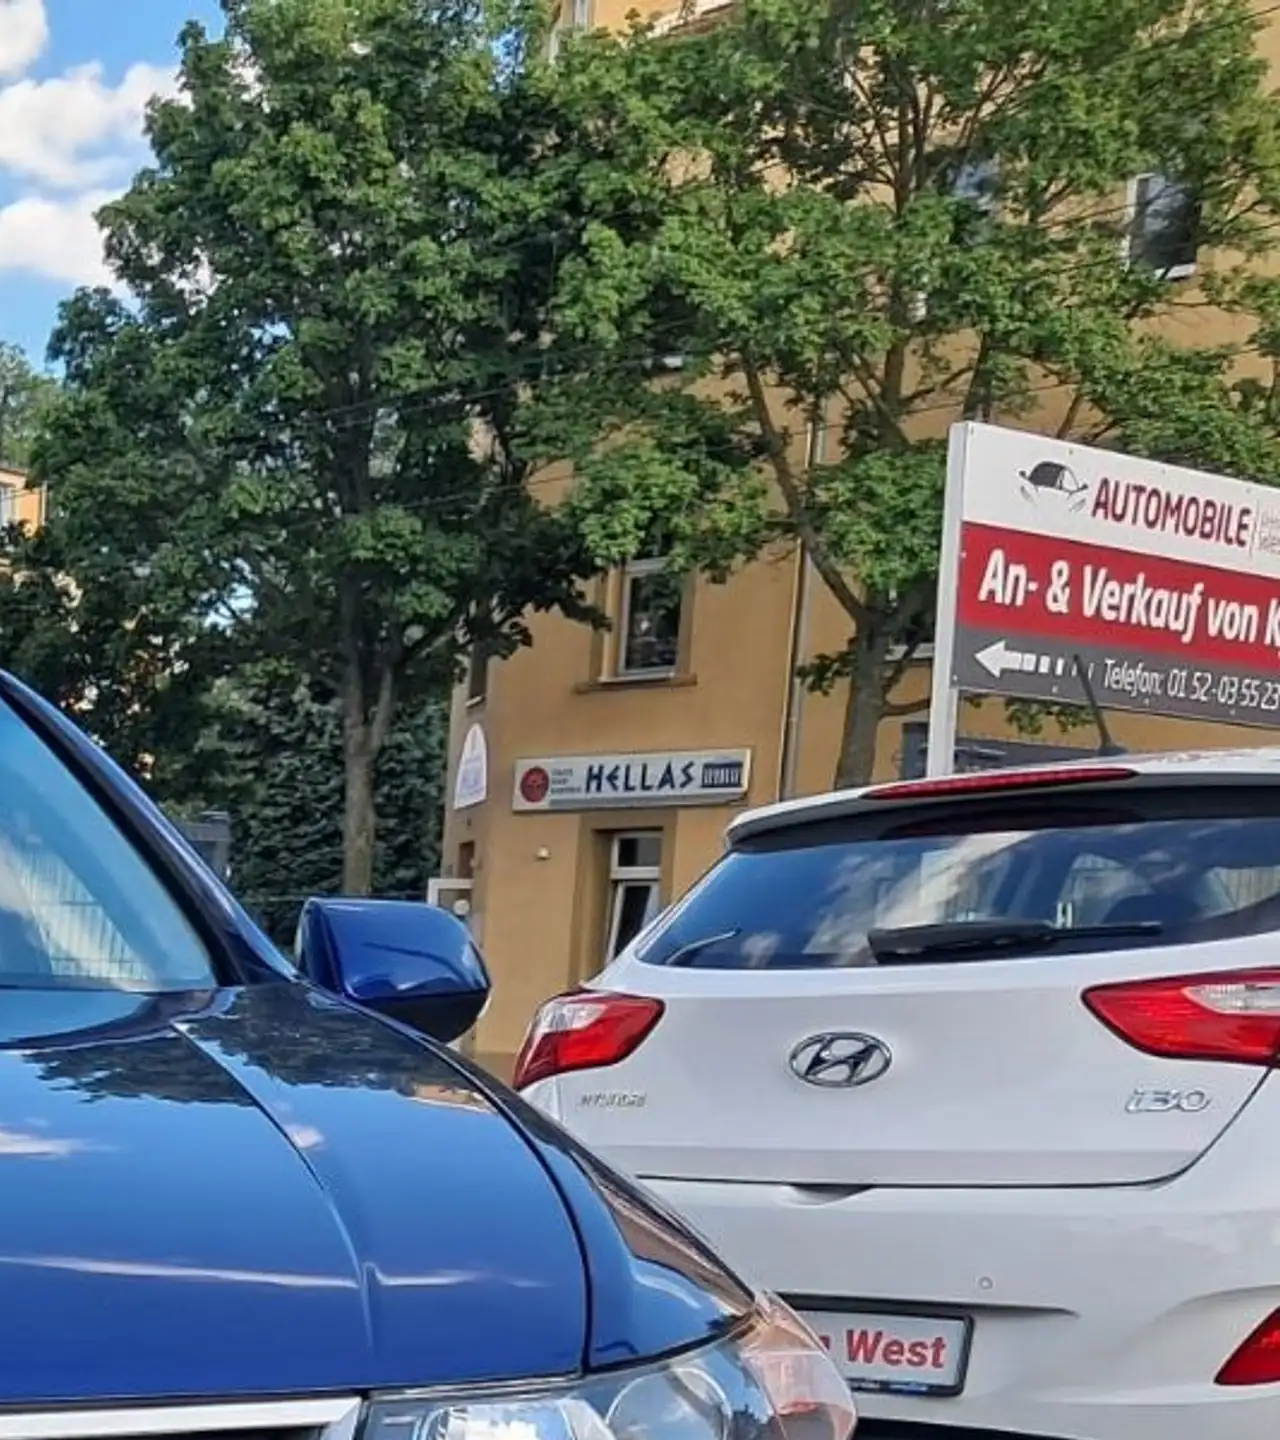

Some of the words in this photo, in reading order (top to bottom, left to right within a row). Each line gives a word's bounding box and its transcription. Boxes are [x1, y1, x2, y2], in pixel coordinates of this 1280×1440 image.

[1091, 478, 1251, 547] AUTOMOBILE
[978, 549, 1038, 606] An-
[1046, 560, 1070, 613] &
[1083, 565, 1204, 643] Verkauf
[1208, 597, 1259, 643] von
[1104, 658, 1164, 698] Telefon:
[586, 761, 695, 793] HELLAS
[846, 1329, 946, 1369] West
